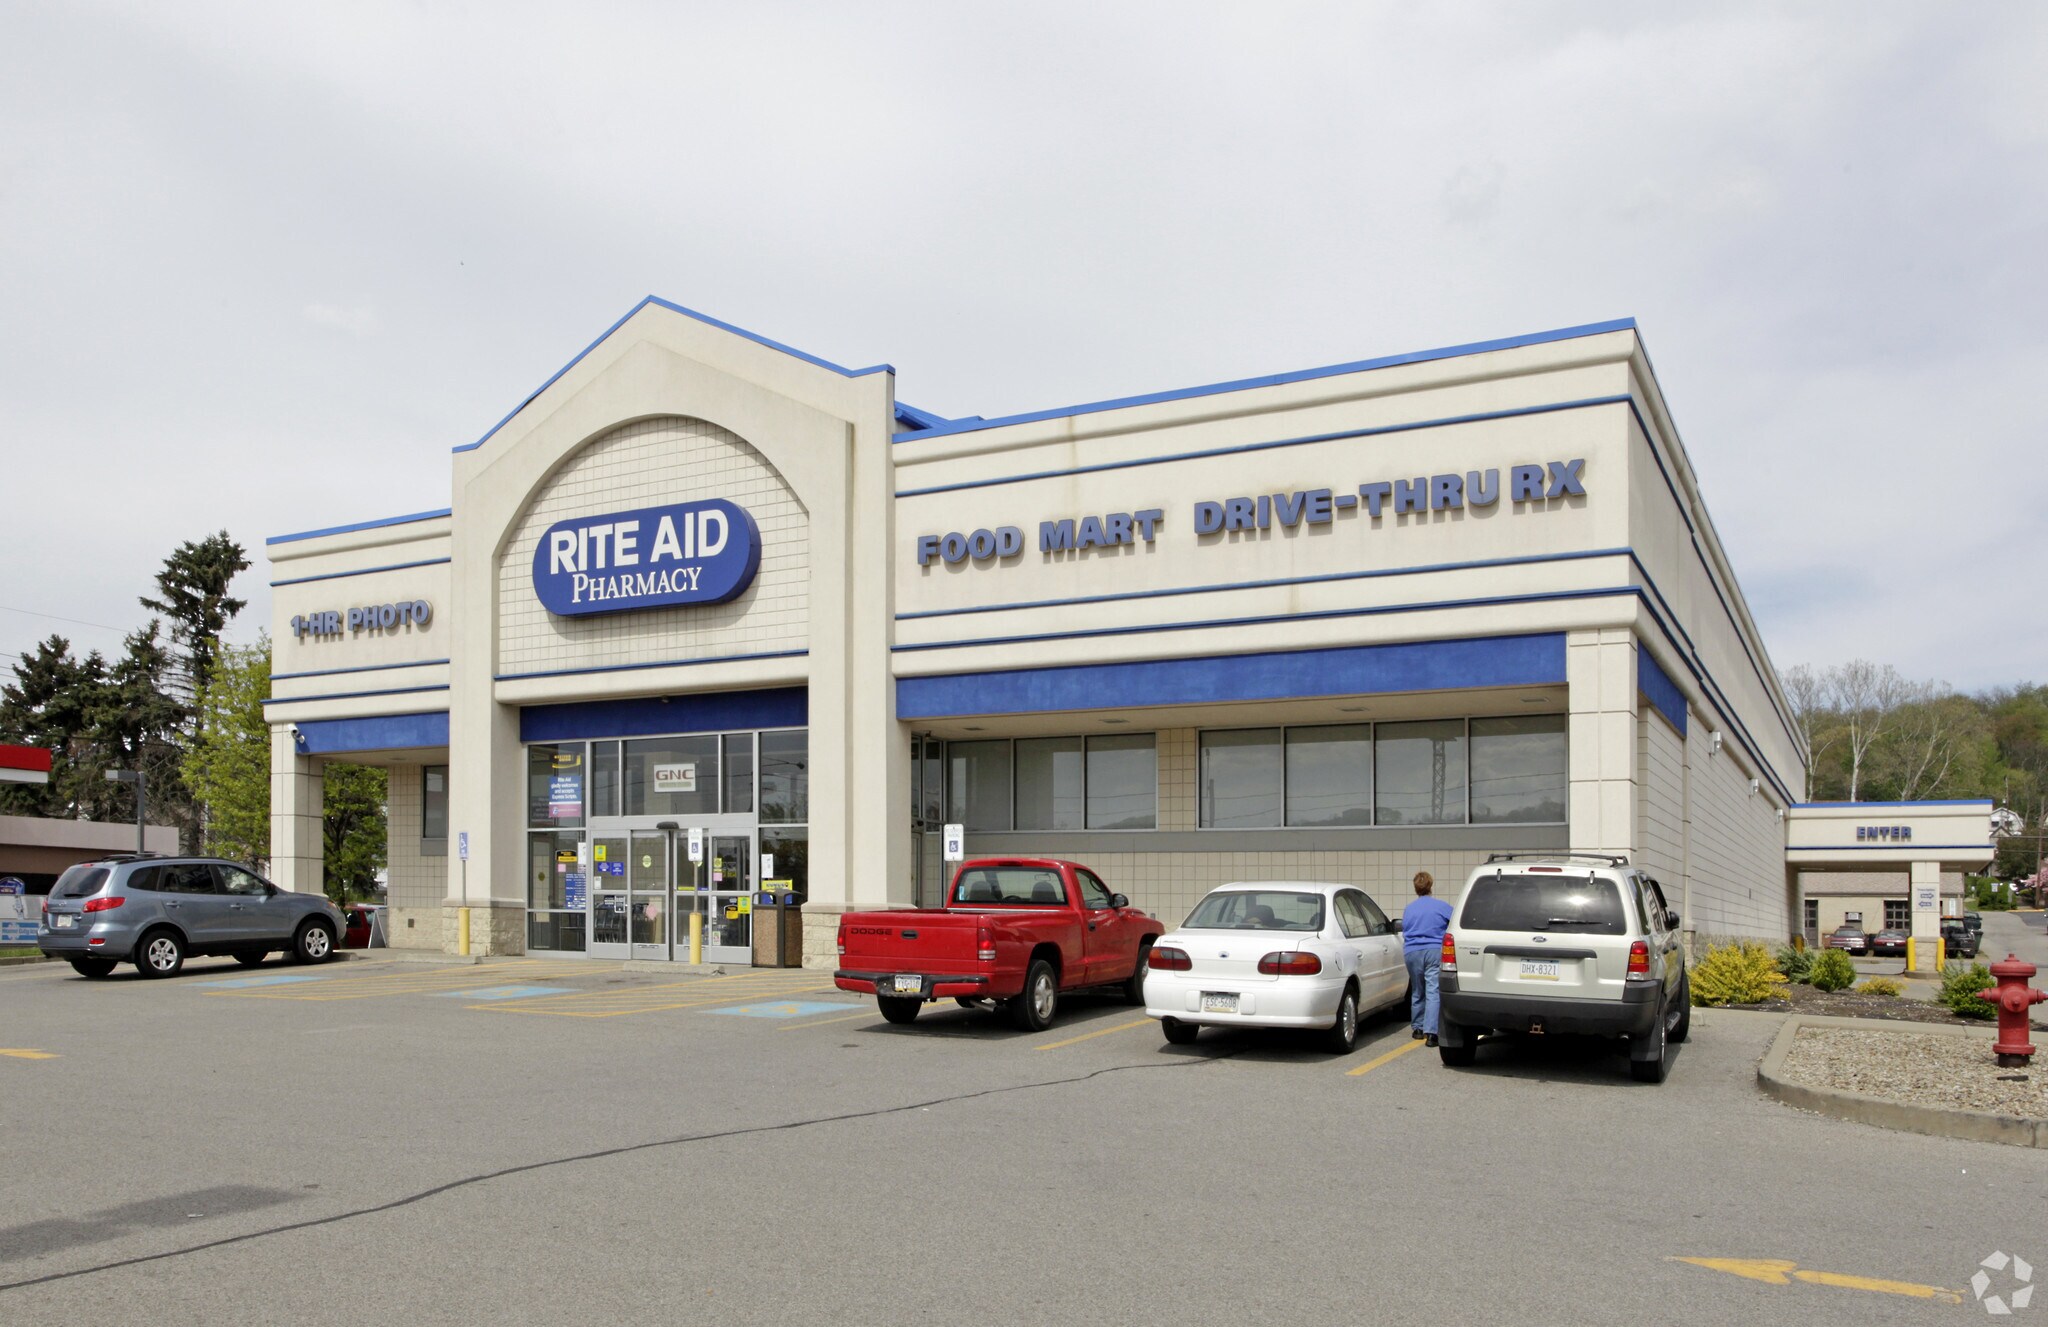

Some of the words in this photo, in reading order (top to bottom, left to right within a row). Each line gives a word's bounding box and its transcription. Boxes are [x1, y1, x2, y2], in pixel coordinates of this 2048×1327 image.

[917, 525, 1024, 566] FOOD
[1039, 508, 1163, 553] MART
[1194, 468, 1500, 535] DRIVE-THRU
[1511, 458, 1587, 502] RX
[550, 520, 639, 575] RITE
[650, 509, 729, 563] AID
[572, 566, 702, 603] PHARMACY
[290, 610, 342, 637] 1-HR
[347, 599, 431, 632] PHOTO
[655, 768, 694, 781] GNC
[1856, 826, 1912, 838] ENTER
[850, 927, 893, 936] DODGE
